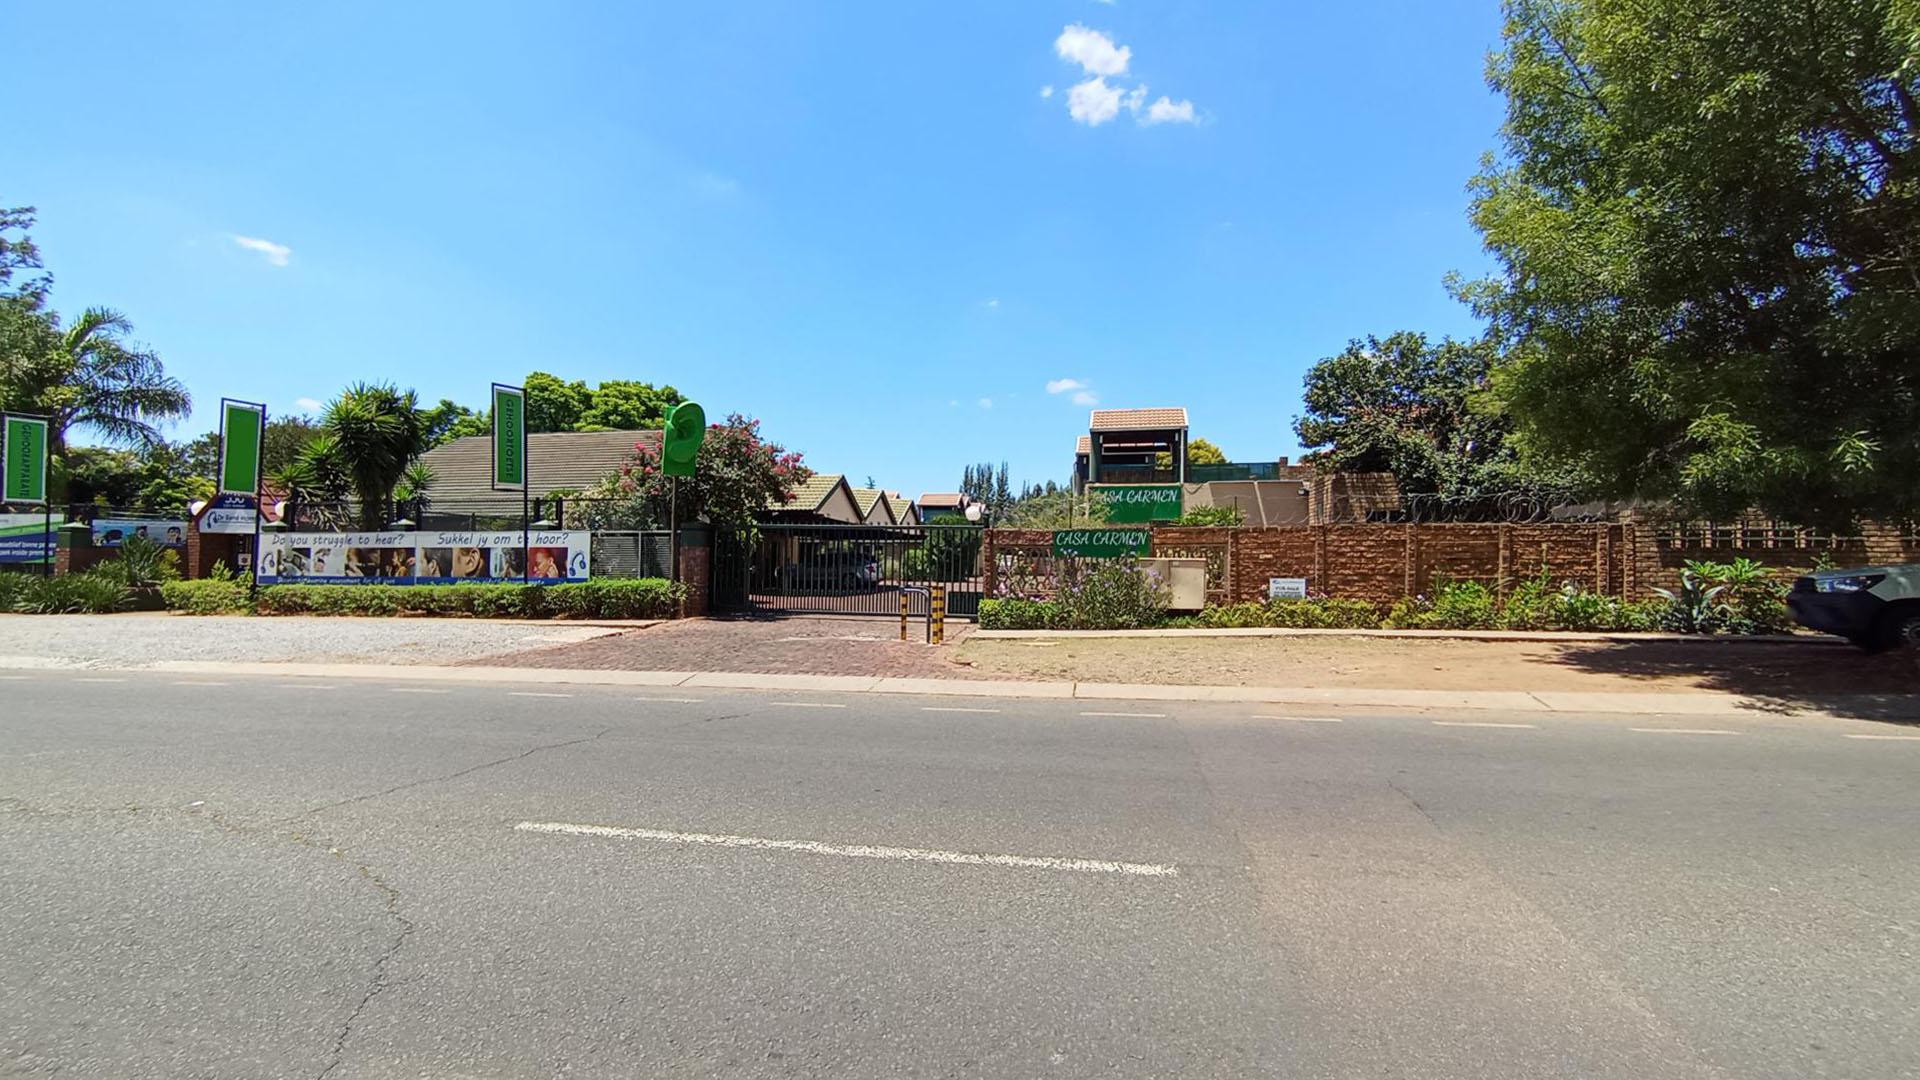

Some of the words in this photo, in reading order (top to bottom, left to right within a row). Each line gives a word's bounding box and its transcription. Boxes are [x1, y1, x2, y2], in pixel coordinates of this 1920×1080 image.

[1126, 489, 1178, 504] CARMEN
[272, 534, 286, 545] Do
[290, 536, 309, 548] you
[313, 534, 352, 548] struggle
[358, 535, 370, 545] to
[375, 533, 404, 545] hear?
[437, 533, 473, 545] Sukkel
[476, 534, 488, 548] jy
[493, 535, 511, 545] om
[535, 533, 569, 545] hoor?
[1056, 531, 1089, 546] CASA
[1092, 531, 1148, 546] CARMEN
